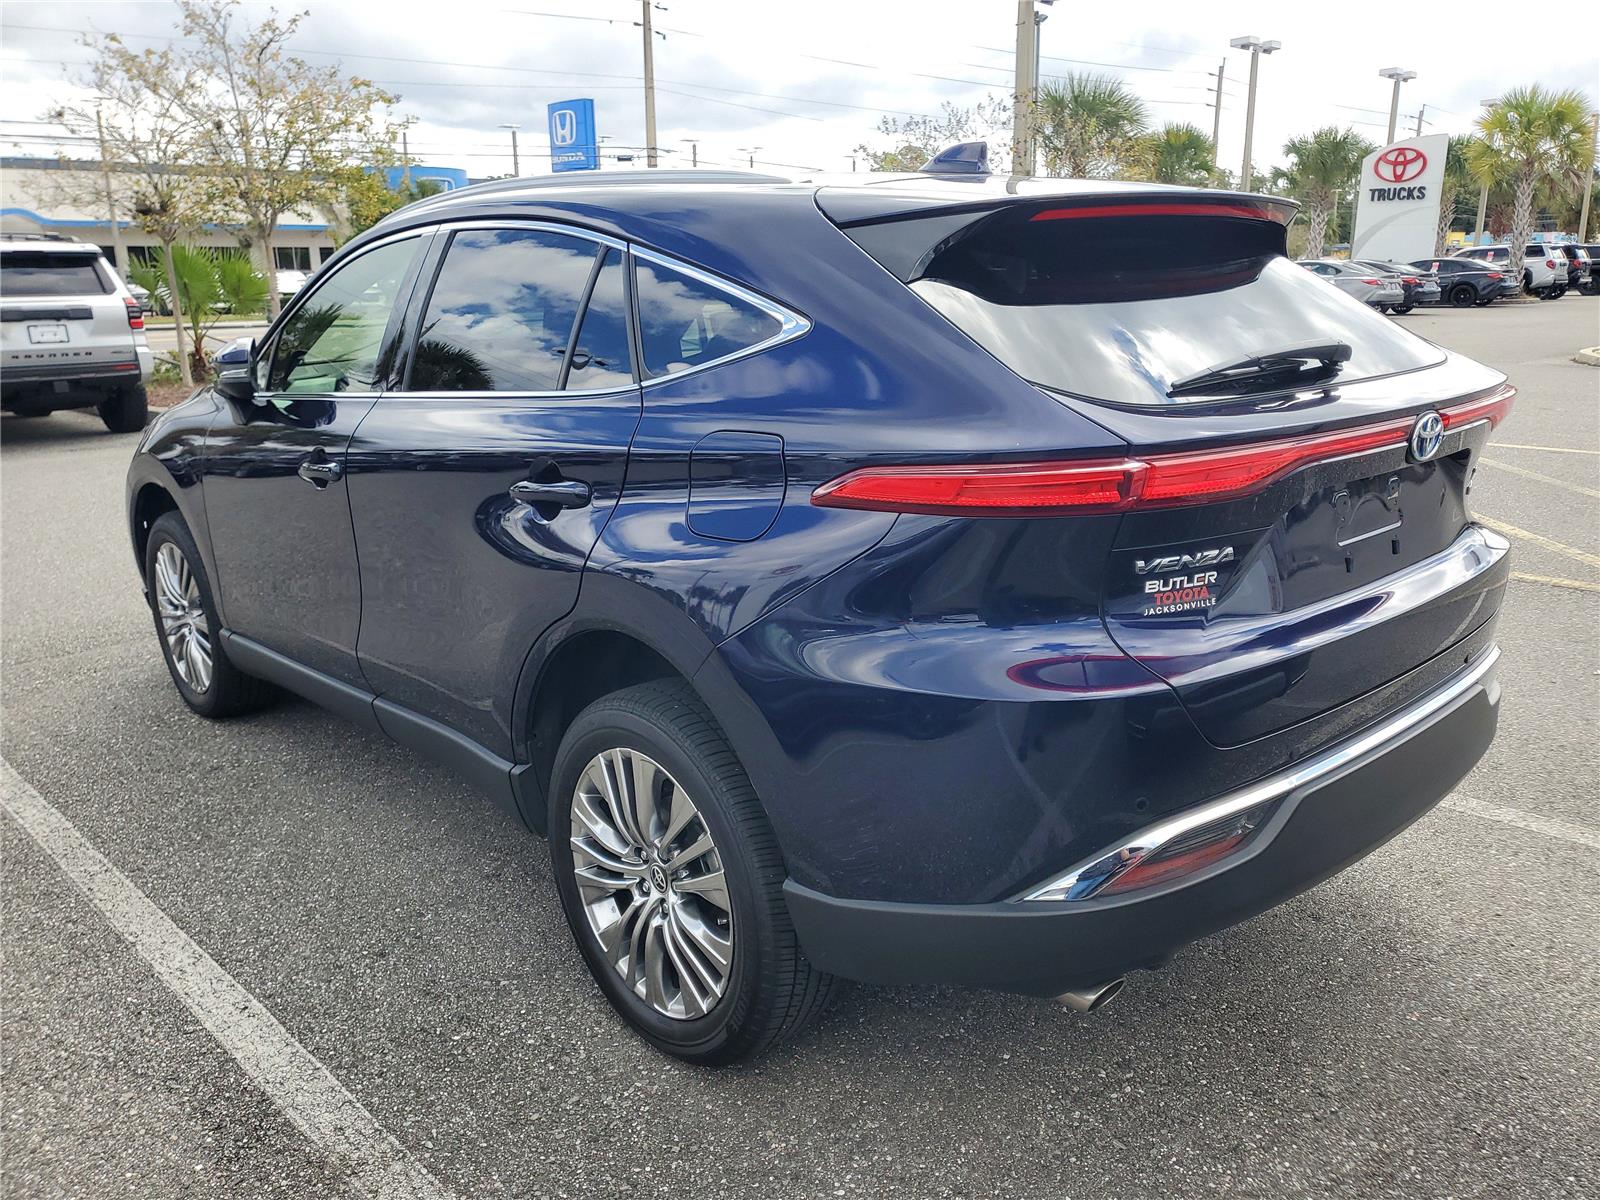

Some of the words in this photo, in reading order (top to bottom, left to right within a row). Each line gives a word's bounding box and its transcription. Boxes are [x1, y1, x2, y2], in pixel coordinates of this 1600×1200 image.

[1369, 186, 1426, 202] TRUCKS
[1135, 547, 1235, 575] VENZA
[1144, 572, 1218, 594] BUTLER
[1154, 586, 1209, 606] TOYOTA
[1143, 598, 1217, 617] JACKSONVILLE
